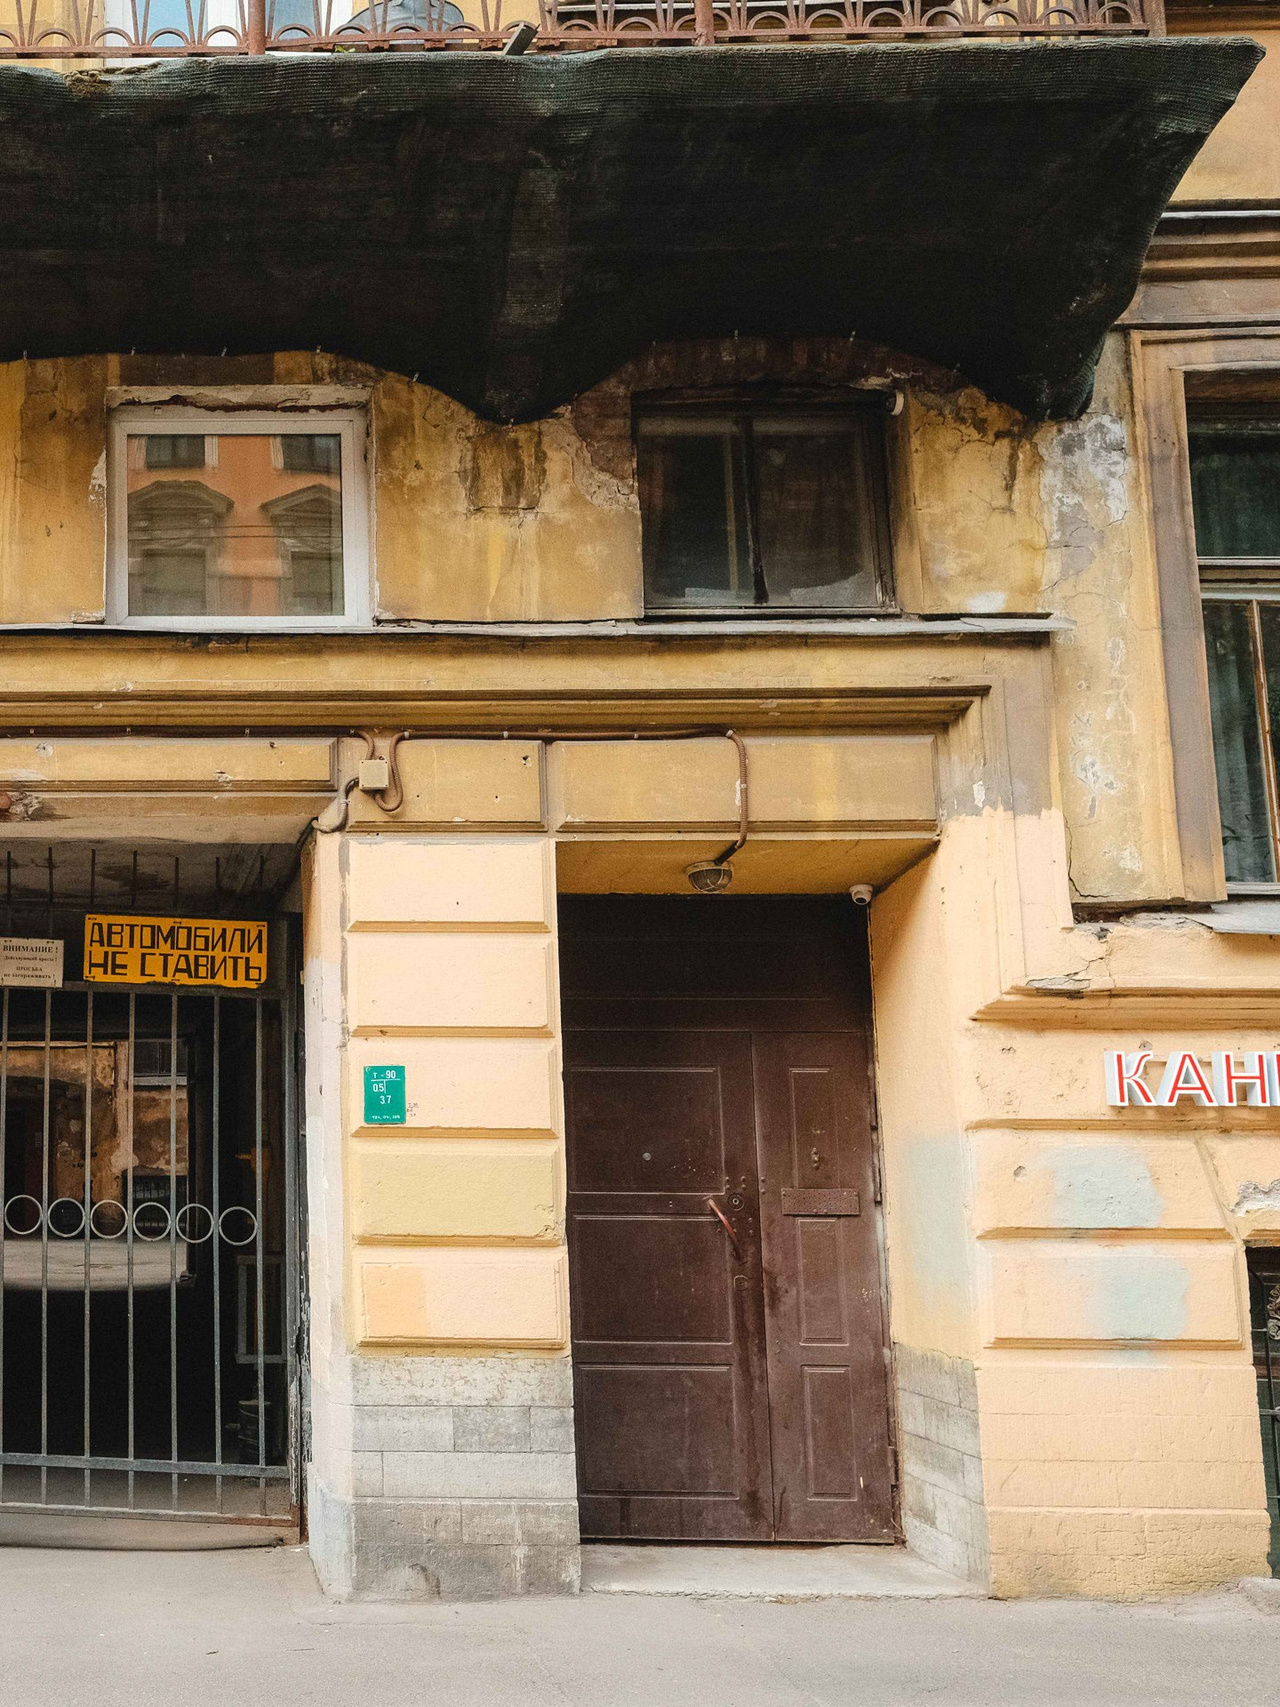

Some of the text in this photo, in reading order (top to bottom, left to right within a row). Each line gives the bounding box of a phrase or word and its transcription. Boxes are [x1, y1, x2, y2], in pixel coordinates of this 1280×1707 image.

[90, 922, 263, 953] АВТОМОБИЛИ
[88, 951, 262, 982] НЕ СТАВИТЬ
[1105, 1051, 1280, 1106] КАН
